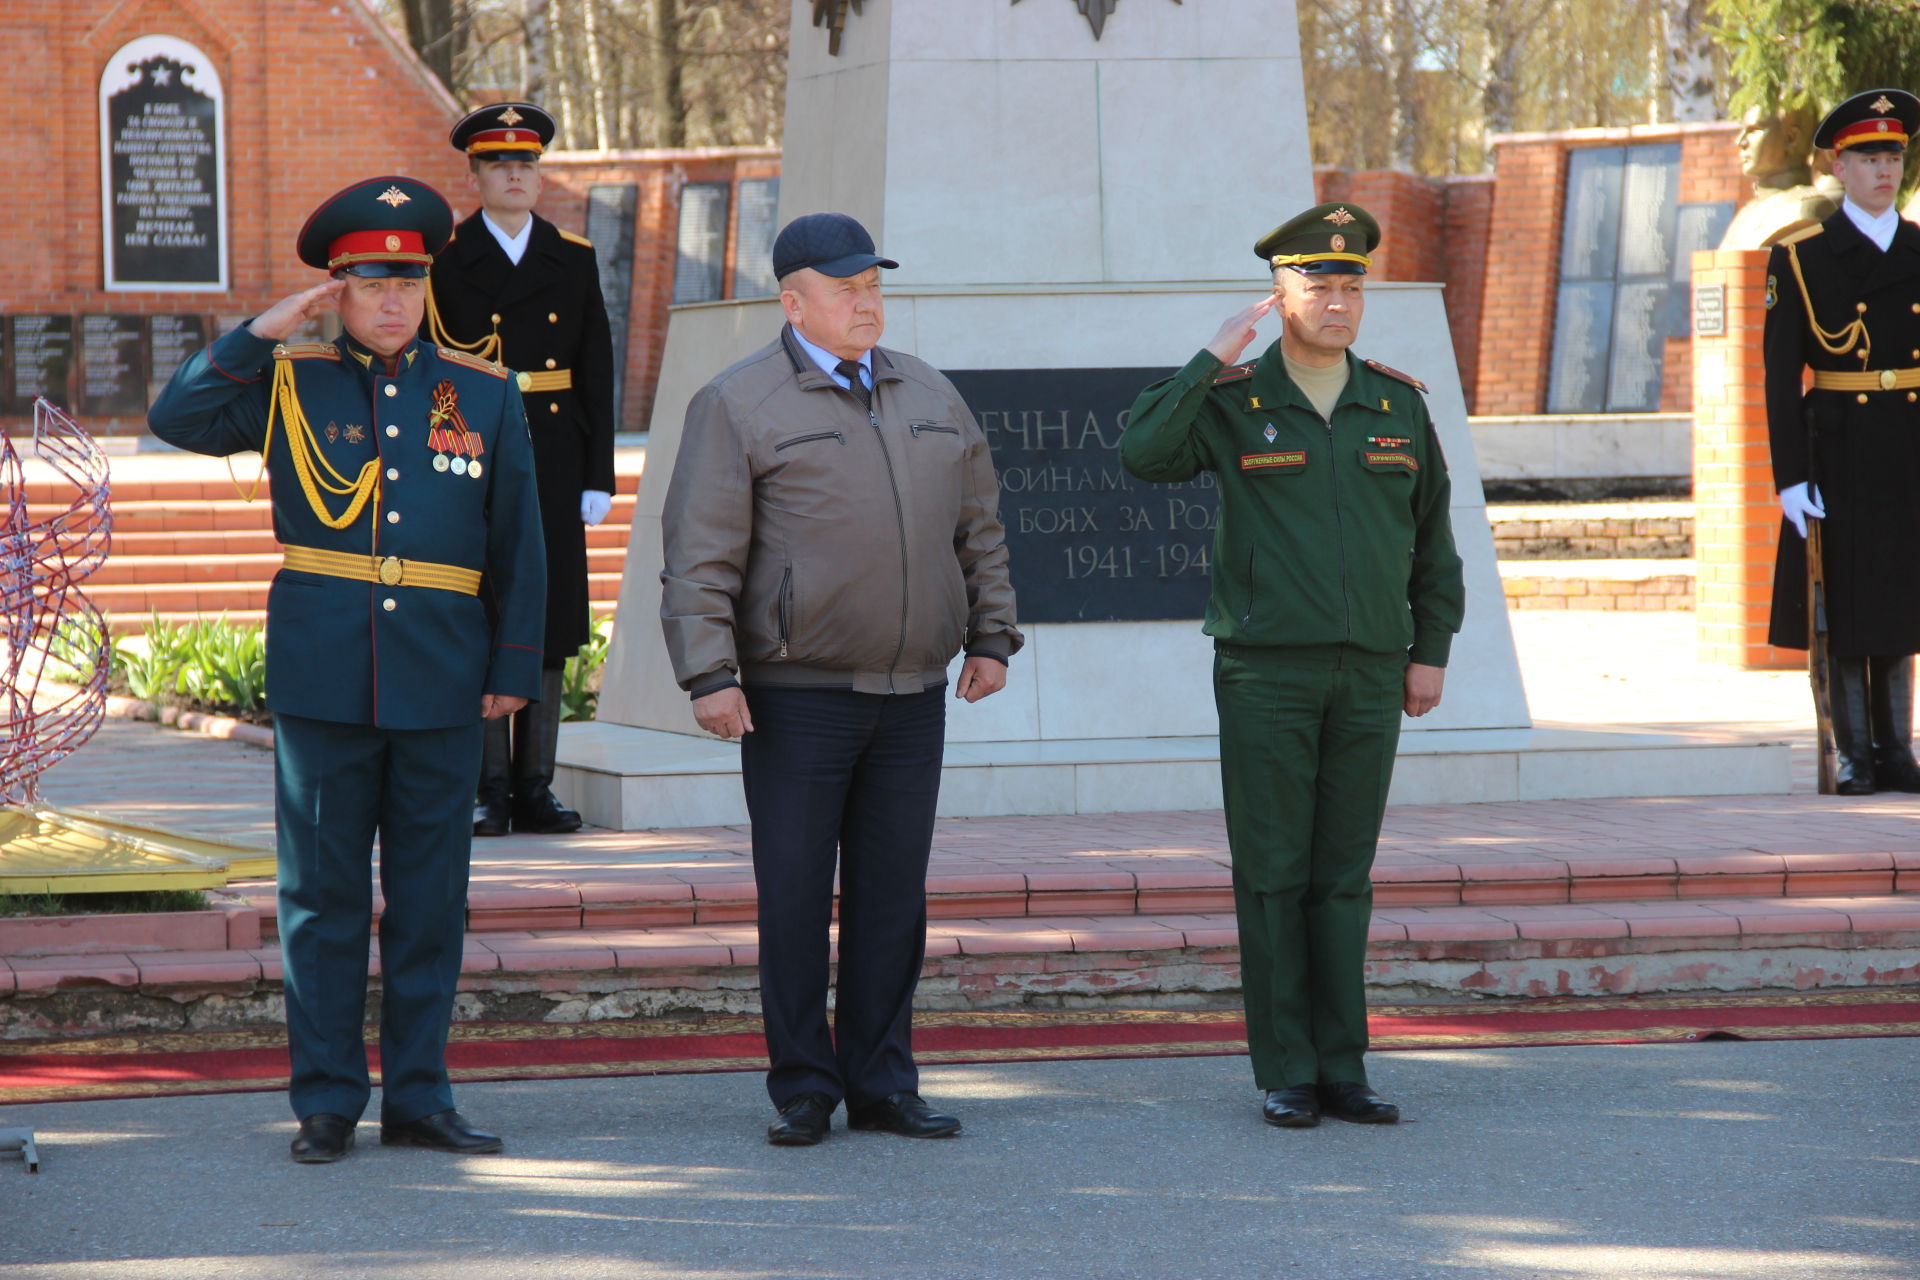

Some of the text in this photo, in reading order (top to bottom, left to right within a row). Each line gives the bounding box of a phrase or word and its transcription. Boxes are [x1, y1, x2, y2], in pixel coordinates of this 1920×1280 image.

[125, 232, 207, 247] ИМ СЛАВА!
[136, 220, 194, 233] ВЕЧНАЯ
[980, 409, 1132, 450] ЕЧНАЯ
[1019, 507, 1098, 534] БОЯХ
[1119, 505, 1154, 532] ЗА
[1063, 543, 1212, 580] 1941-194
